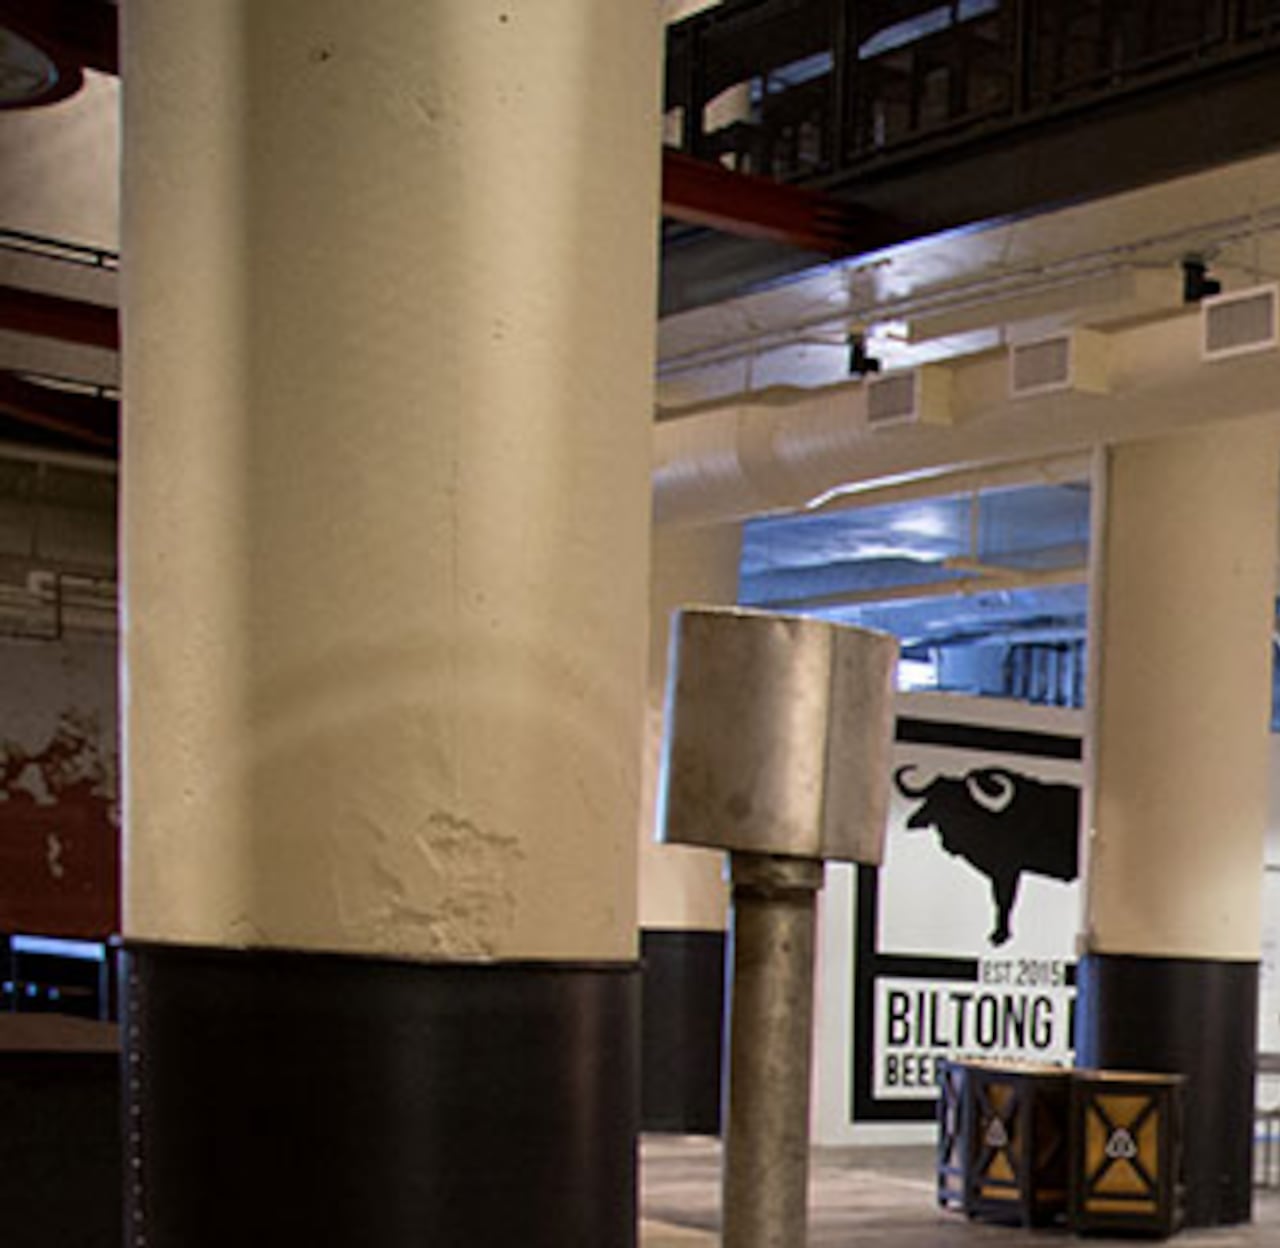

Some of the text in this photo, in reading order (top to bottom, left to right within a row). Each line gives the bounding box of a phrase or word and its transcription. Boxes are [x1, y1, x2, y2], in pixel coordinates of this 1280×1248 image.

[983, 959, 1064, 985] EST 2015
[887, 990, 1052, 1049] BILTONG
